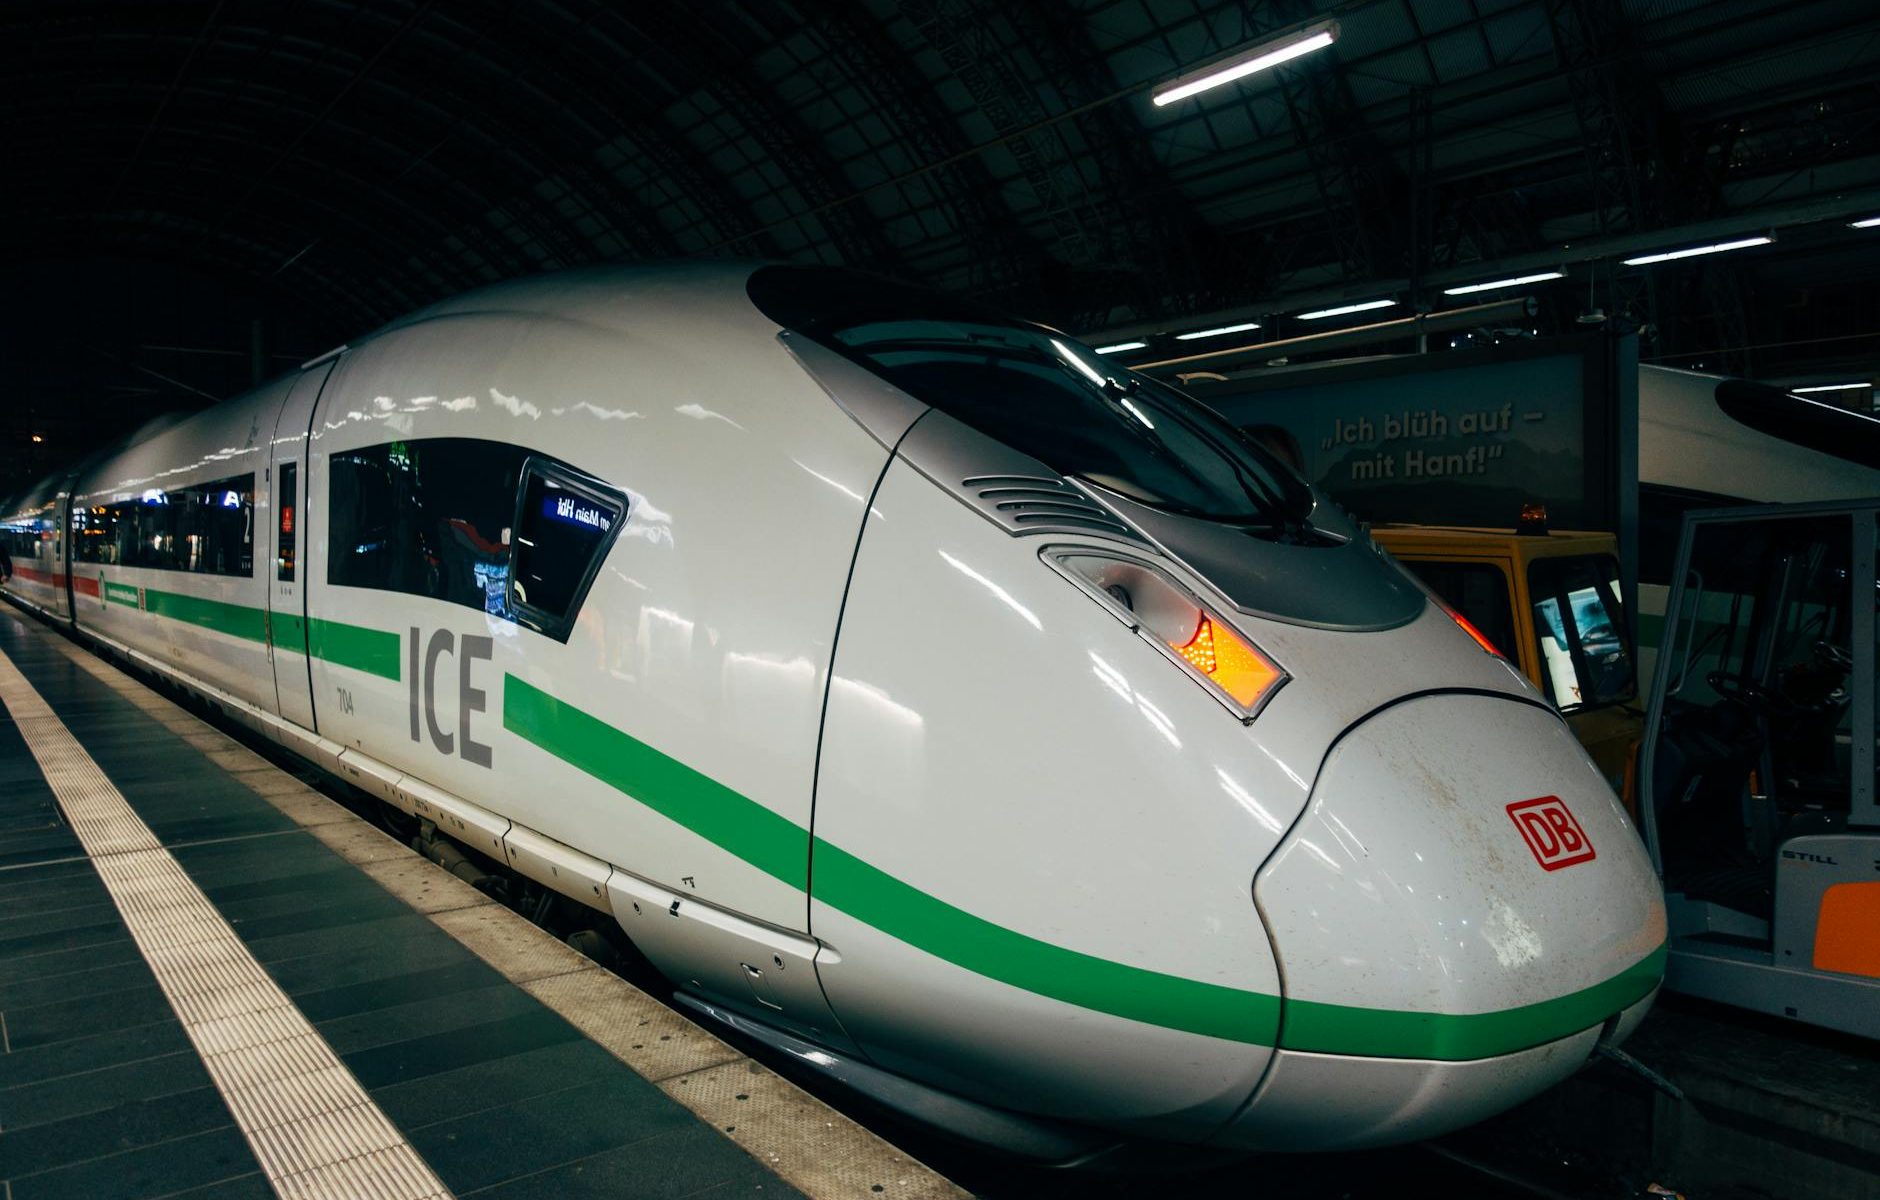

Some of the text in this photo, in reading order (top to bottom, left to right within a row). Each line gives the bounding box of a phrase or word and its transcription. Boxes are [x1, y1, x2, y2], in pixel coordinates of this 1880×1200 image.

[1321, 417, 1376, 451] „Ich
[1384, 409, 1448, 440] blüh
[1458, 402, 1513, 434] auf
[1351, 444, 1504, 480] mit Hanf!“
[336, 686, 355, 716] 704
[409, 626, 494, 769] ICE
[1518, 807, 1583, 859] DB
[1782, 850, 1839, 866] STILL
